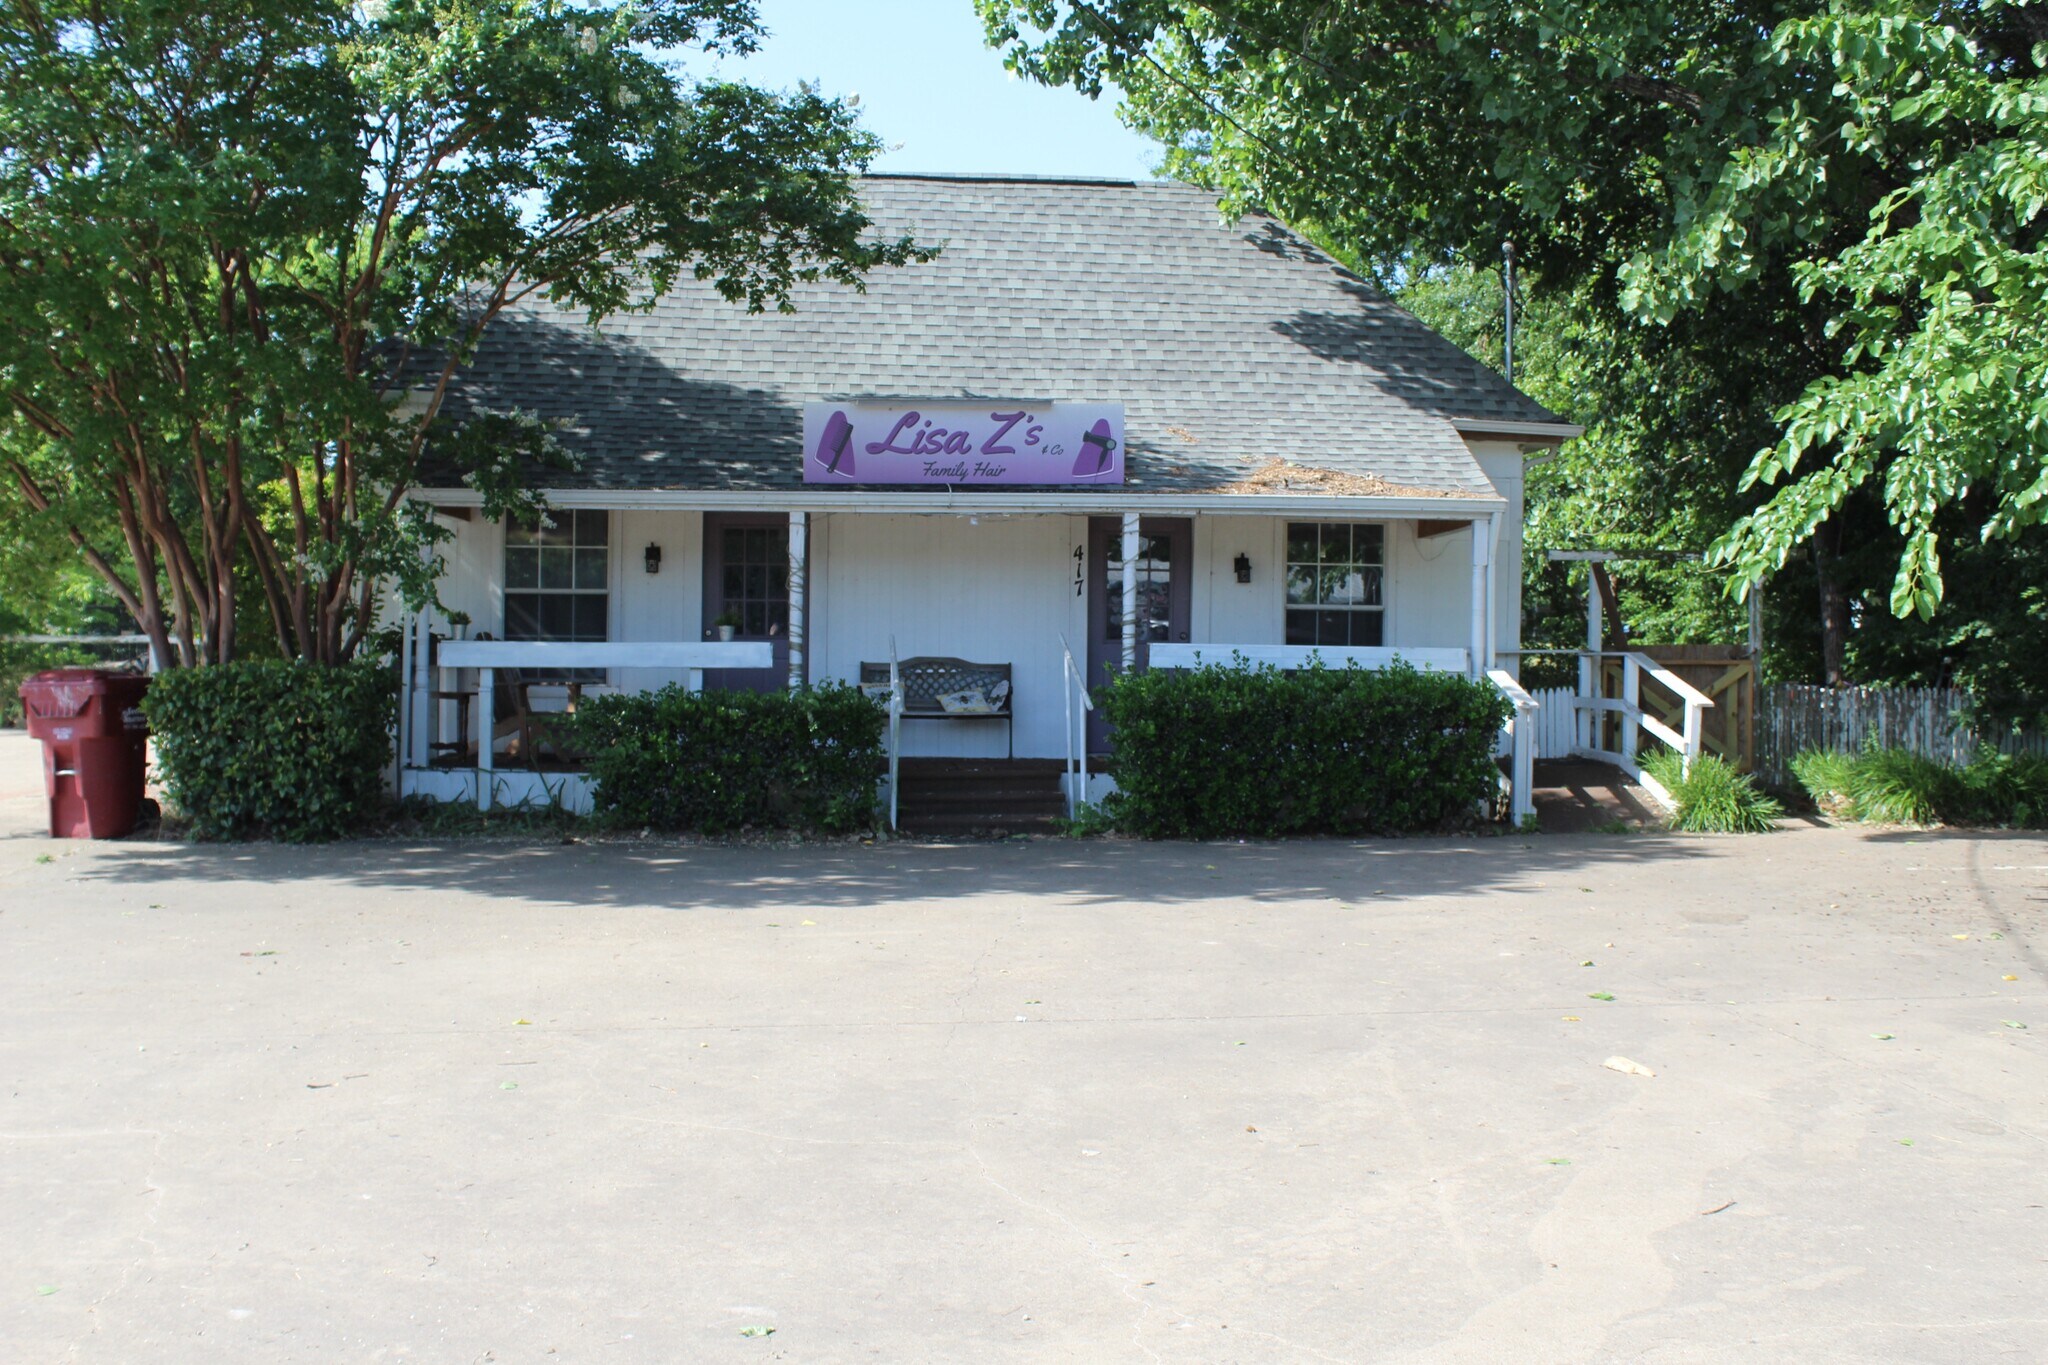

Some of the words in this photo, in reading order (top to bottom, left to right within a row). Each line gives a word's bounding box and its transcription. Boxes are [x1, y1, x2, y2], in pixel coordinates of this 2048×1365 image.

[865, 411, 971, 455] Lisa
[980, 410, 1043, 455] Z's
[1051, 444, 1064, 456] Co
[923, 461, 968, 481] Family
[973, 461, 1006, 478] Hair
[1073, 544, 1084, 597] 417
